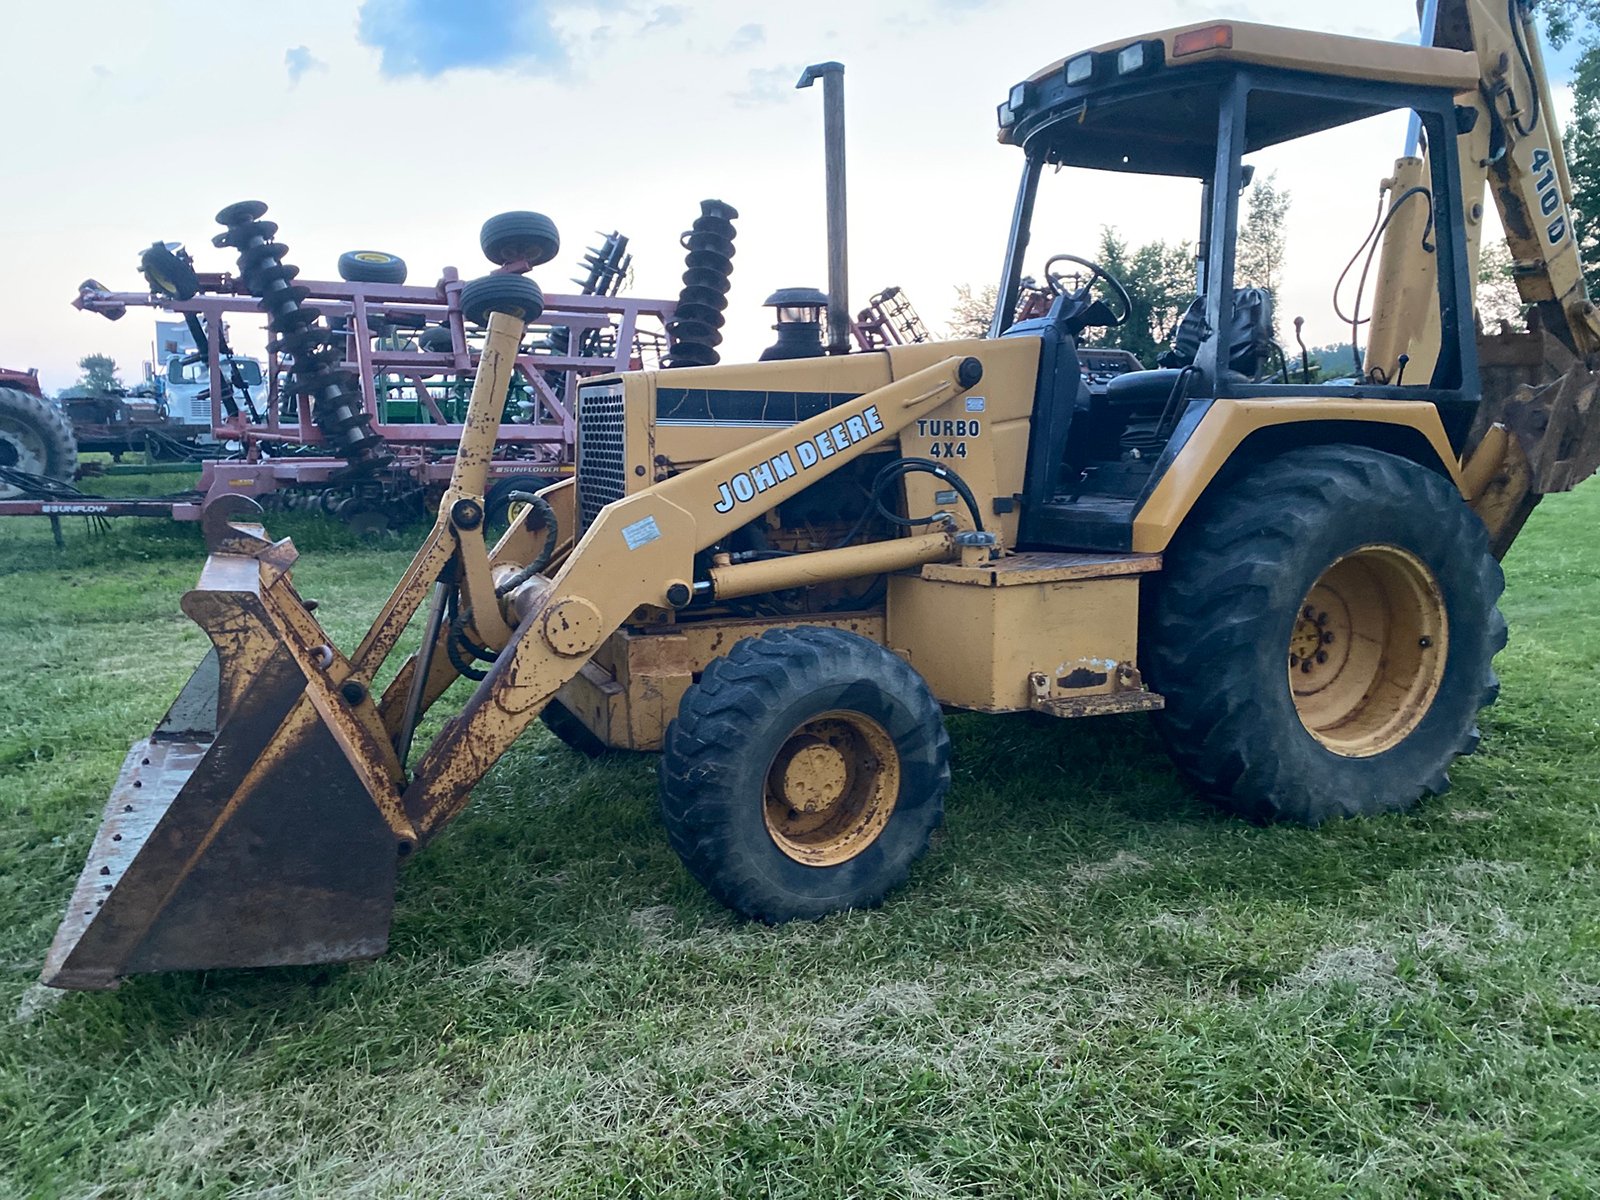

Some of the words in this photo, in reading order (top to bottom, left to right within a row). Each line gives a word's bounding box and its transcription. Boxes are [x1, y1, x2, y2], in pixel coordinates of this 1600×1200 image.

[1531, 148, 1566, 245] 410D
[917, 419, 980, 437] TURBO
[930, 442, 967, 458] 4X4
[714, 451, 797, 513] JOHN
[795, 404, 884, 470] DEERE
